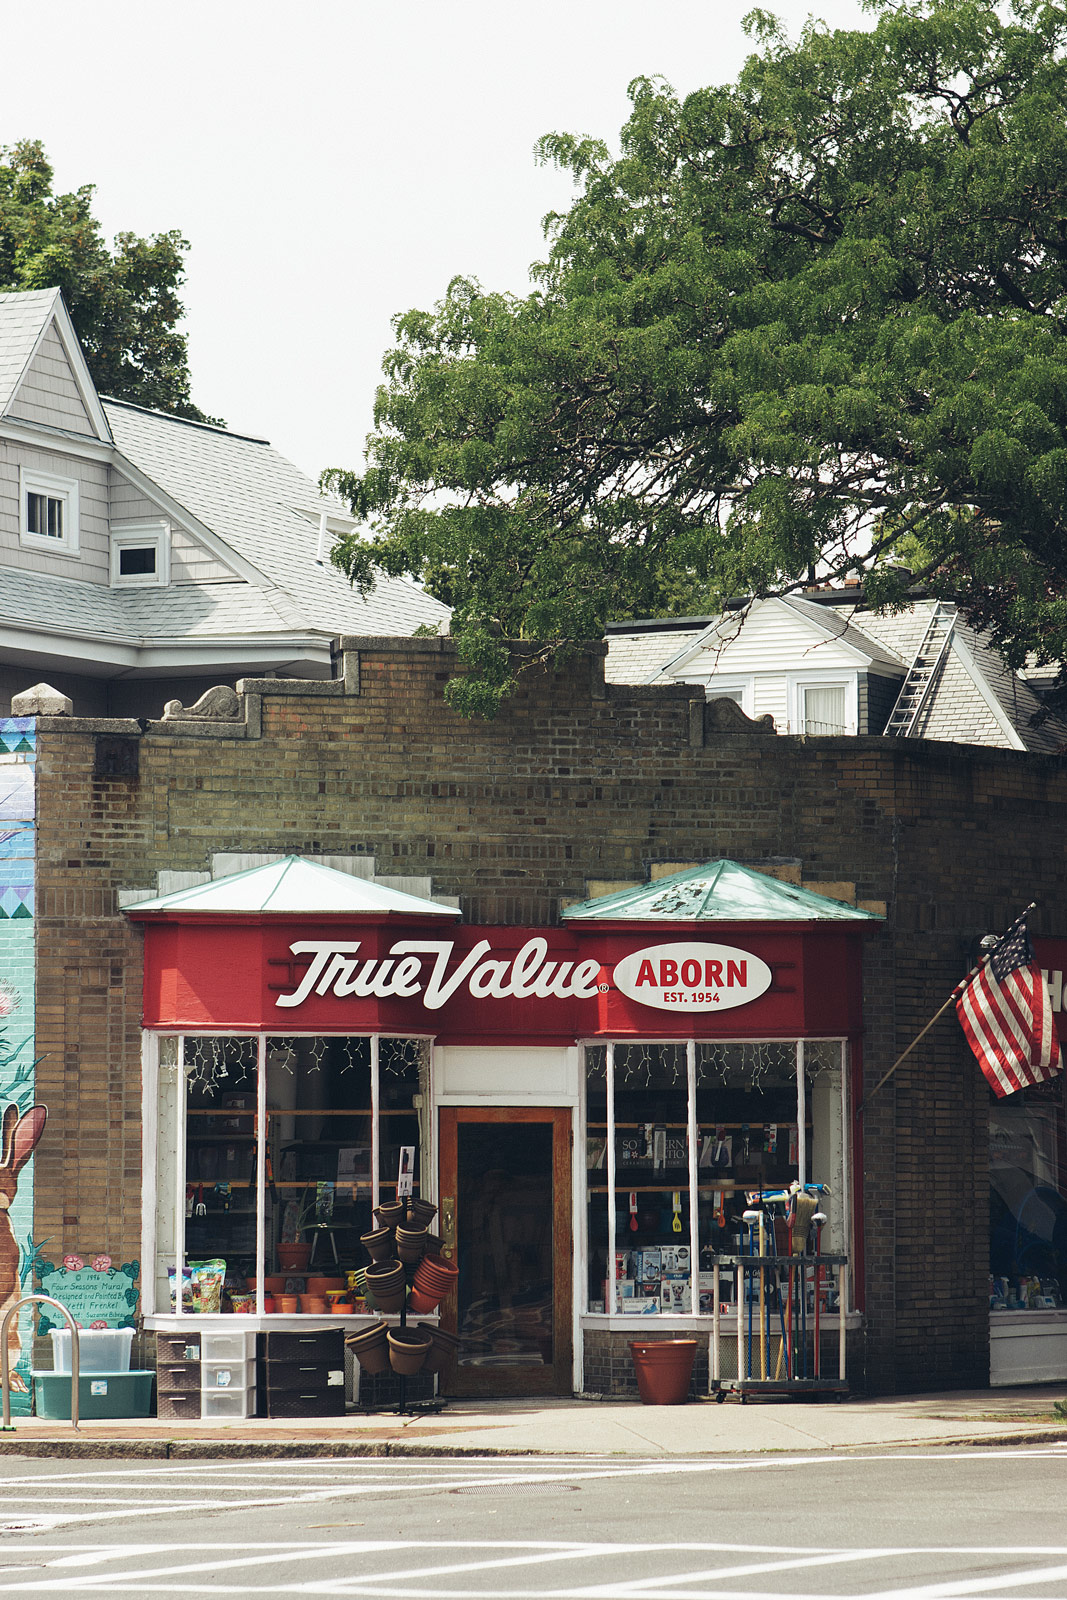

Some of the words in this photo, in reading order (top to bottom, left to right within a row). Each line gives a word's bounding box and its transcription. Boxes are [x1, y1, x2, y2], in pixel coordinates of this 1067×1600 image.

[275, 940, 422, 1008] True
[635, 958, 748, 988] ABORN
[663, 992, 688, 1003] EST.
[691, 992, 720, 1003] 1954
[69, 1283, 98, 1291] Seasons
[52, 1293, 83, 1301] Designed
[95, 1292, 117, 1300] Painted
[89, 1302, 119, 1310] Frenkel
